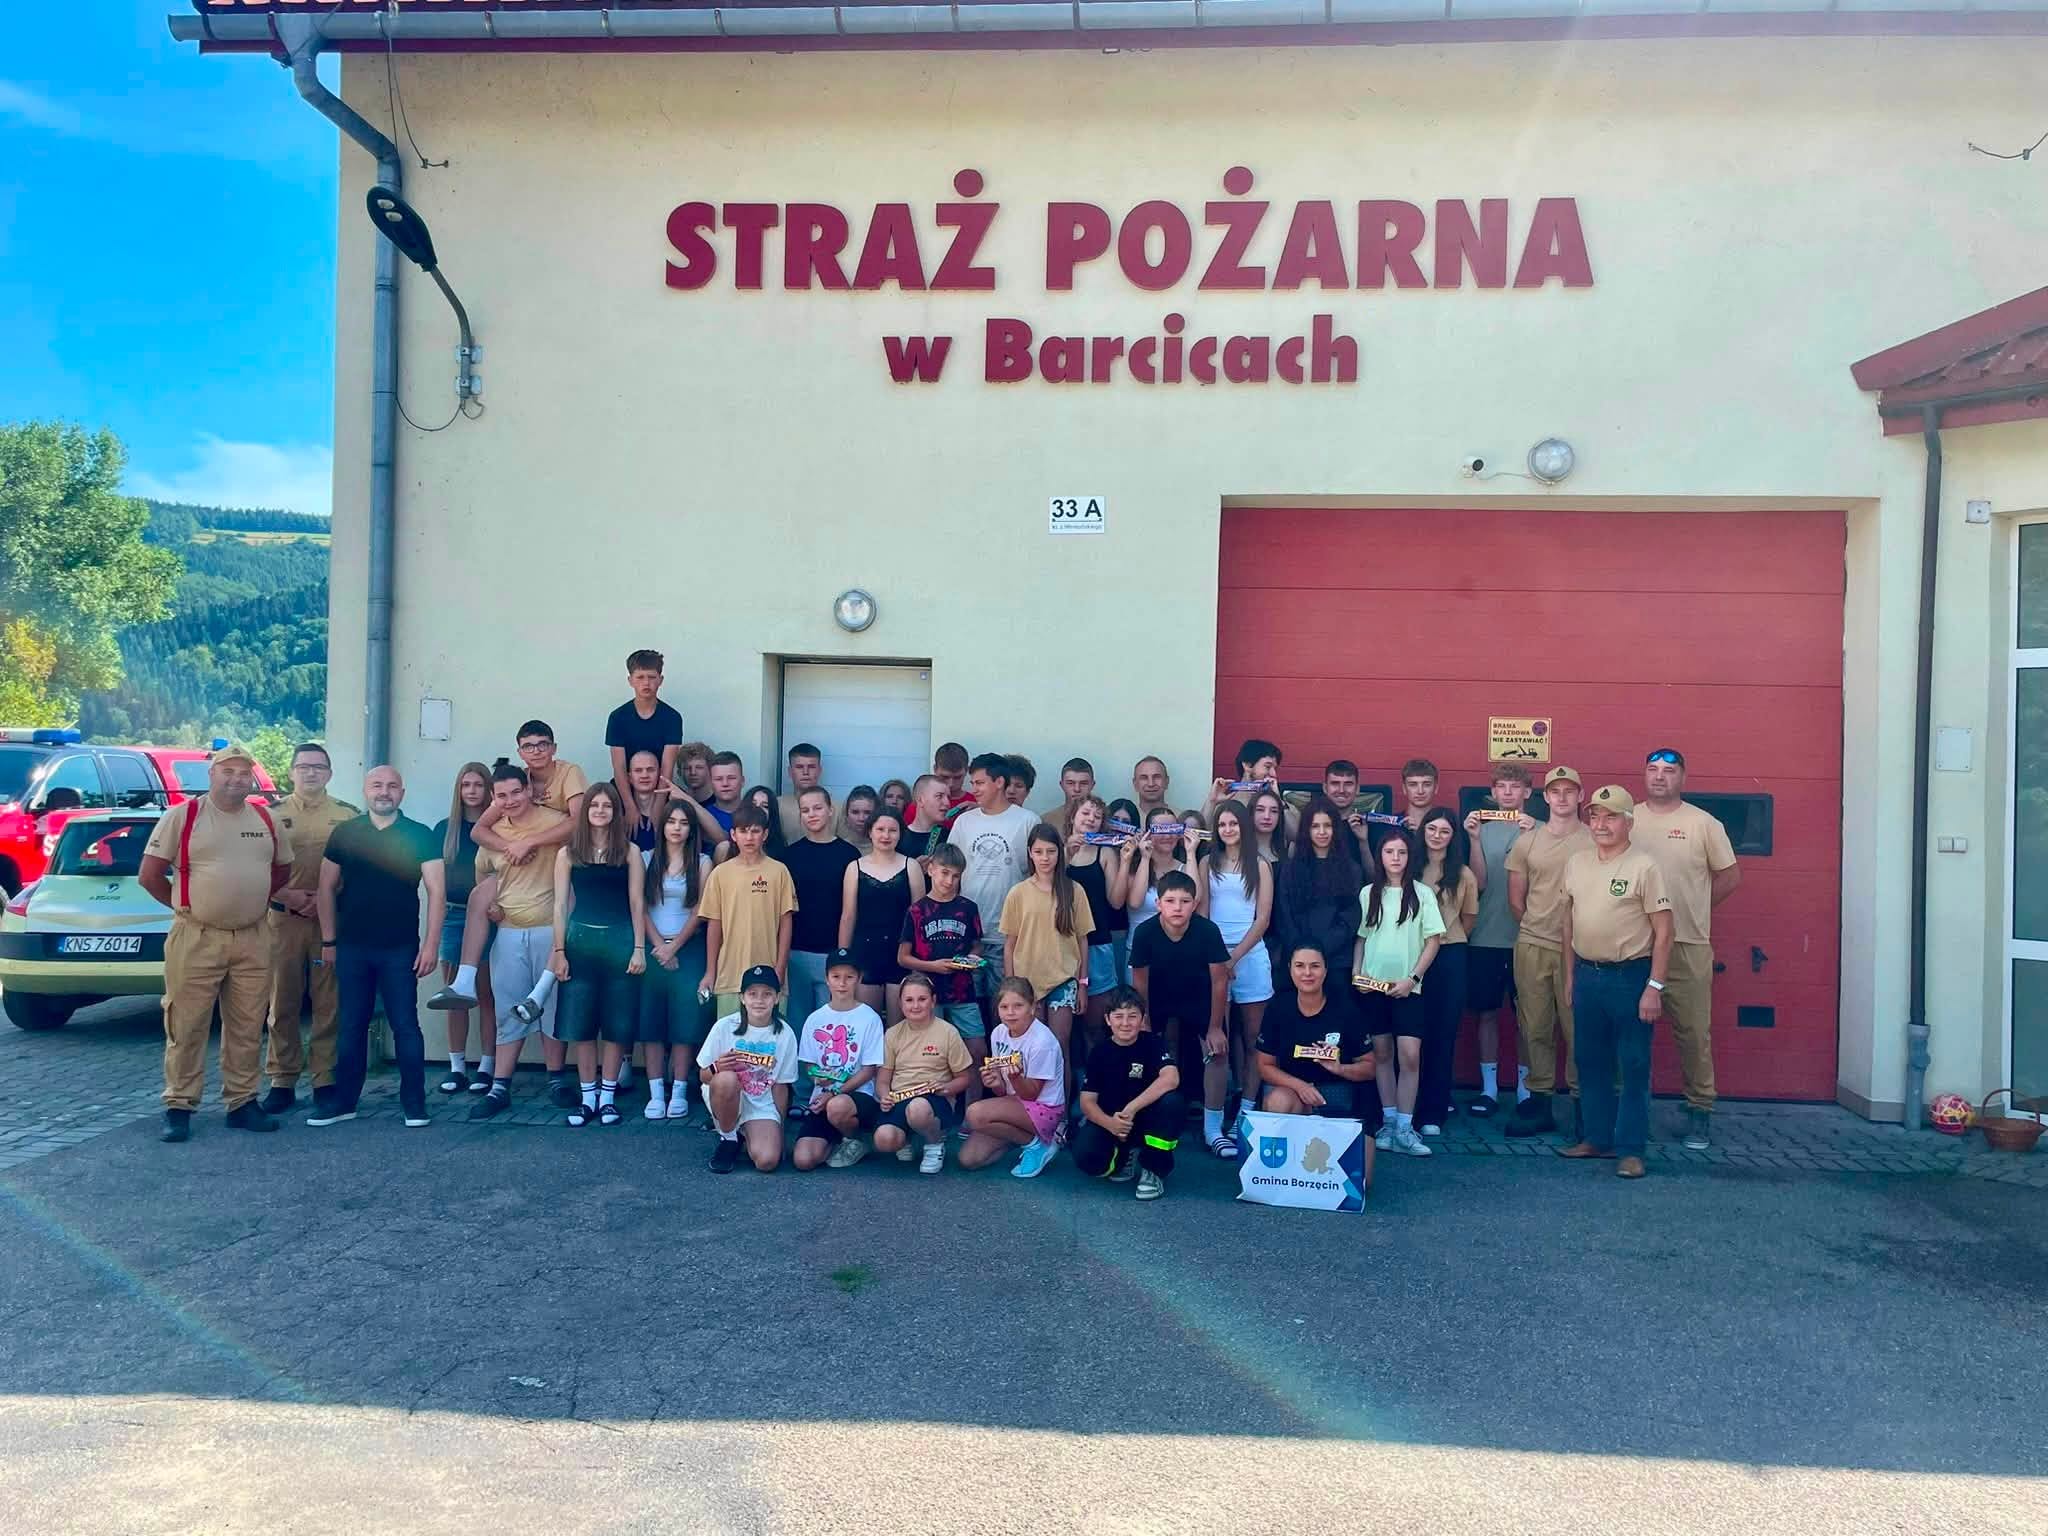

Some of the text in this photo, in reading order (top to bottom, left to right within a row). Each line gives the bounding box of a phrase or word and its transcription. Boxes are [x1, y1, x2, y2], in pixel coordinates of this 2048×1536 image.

[665, 166, 1595, 291] STRAŻ POŻARNA
[882, 313, 1360, 384] w Barcicach
[1051, 499, 1102, 518] 33 A
[64, 937, 140, 952] KNS 76014
[1251, 1175, 1289, 1187] Gmina
